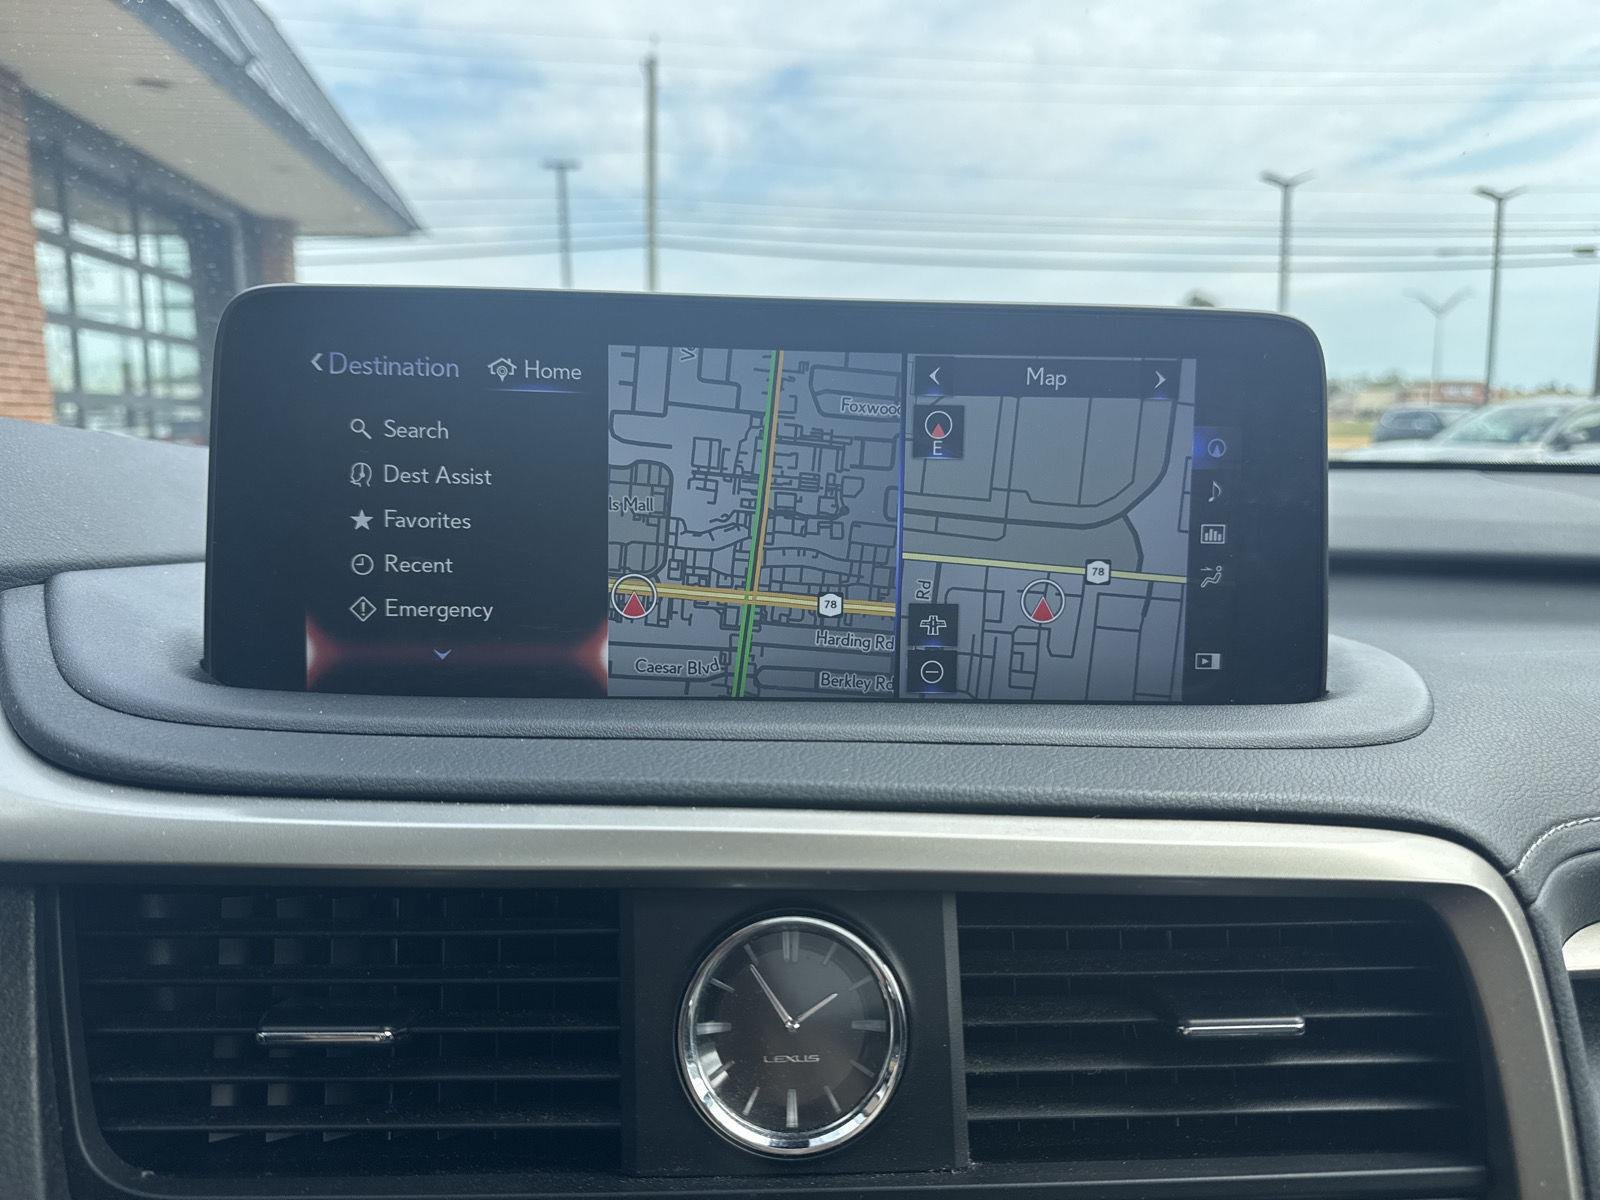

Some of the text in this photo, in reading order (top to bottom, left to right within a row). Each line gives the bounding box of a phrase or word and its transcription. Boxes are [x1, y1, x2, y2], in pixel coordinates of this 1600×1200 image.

[328, 351, 460, 378] Destination
[524, 359, 583, 380] Home
[1025, 367, 1067, 390] Map
[383, 419, 450, 440] Search
[932, 440, 943, 456] E
[383, 464, 493, 486] Dest Assist
[624, 496, 653, 512] Mall
[384, 509, 472, 531] Favorites
[384, 554, 453, 575] Recent
[1091, 567, 1106, 577] 78
[915, 579, 931, 600] Rd
[384, 599, 494, 623] Emergency
[823, 599, 838, 610] 78
[816, 630, 895, 652] Harding Rd
[635, 657, 720, 676] Caesar Blvd
[820, 672, 871, 693] Berkley
[763, 1054, 820, 1064] LEXUS
